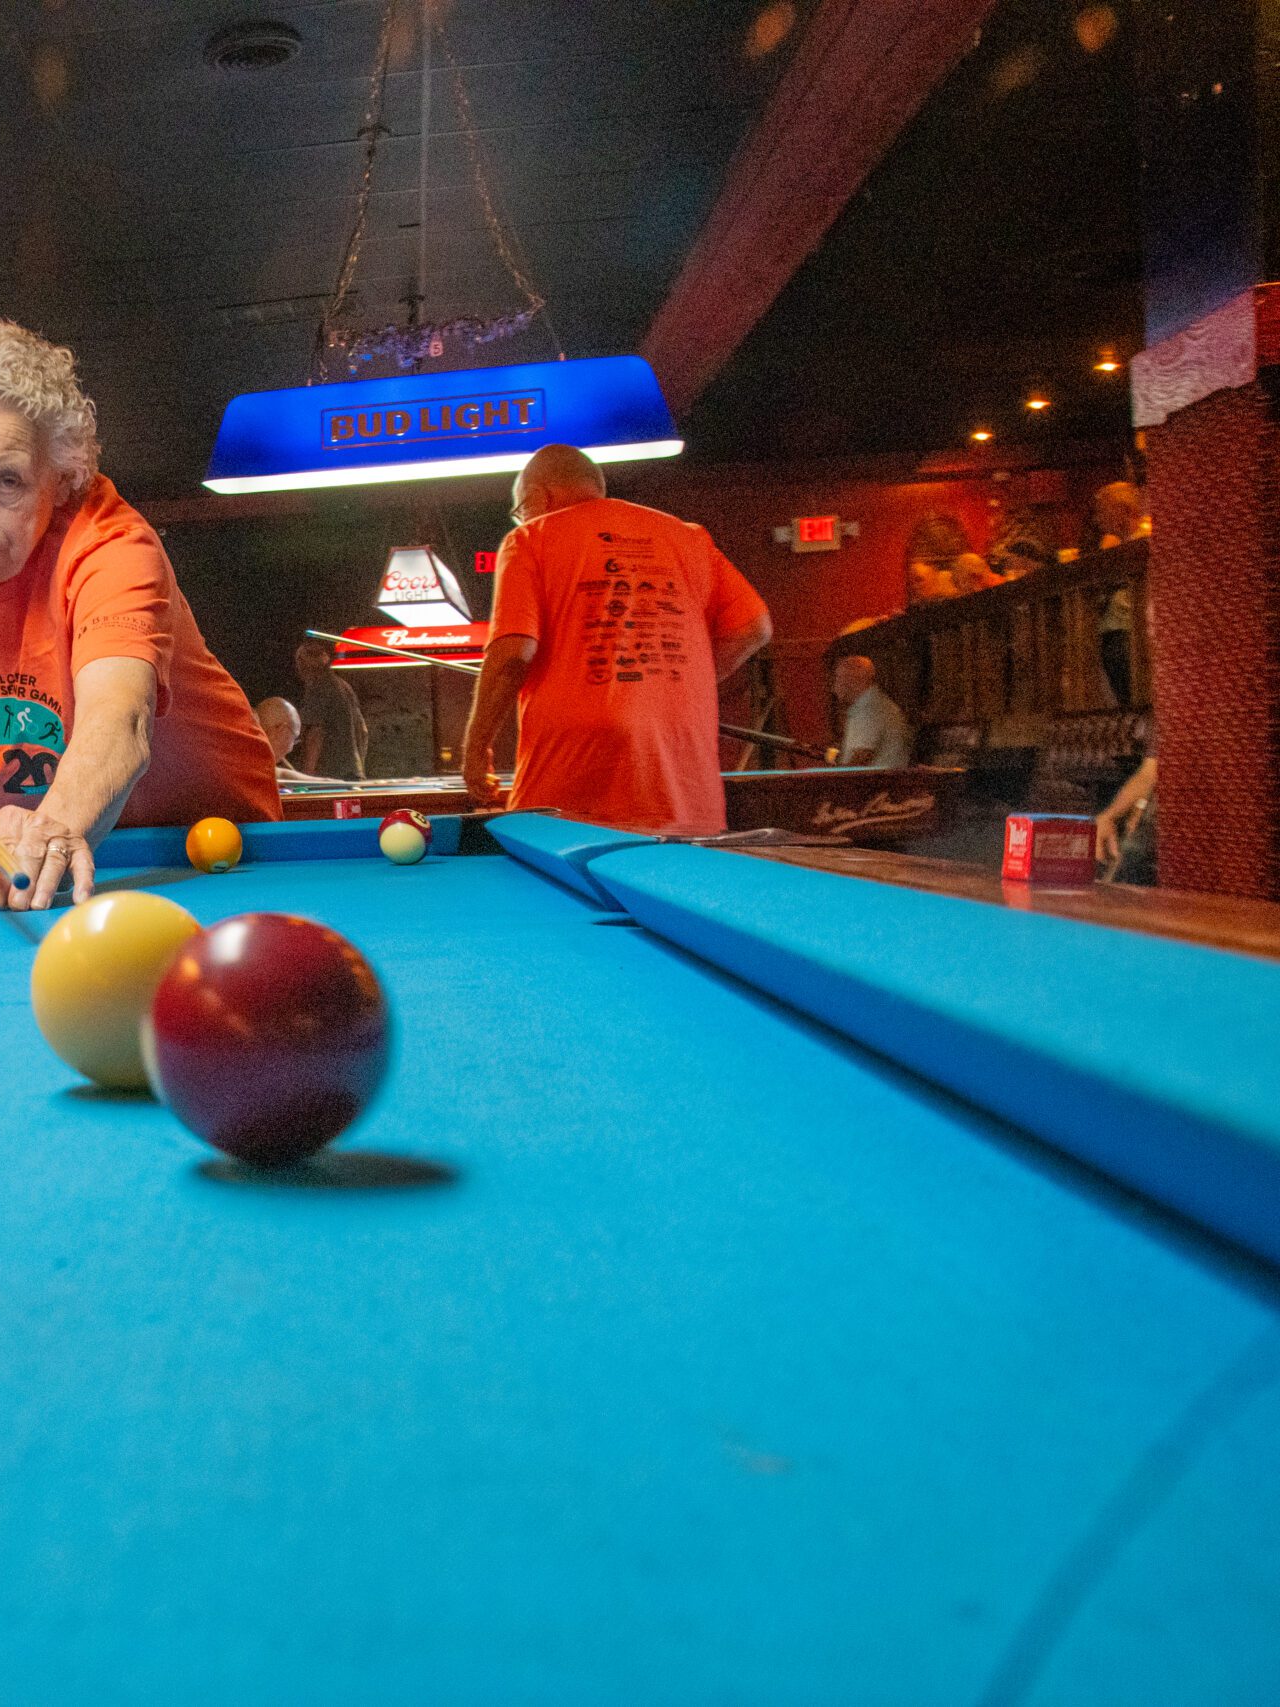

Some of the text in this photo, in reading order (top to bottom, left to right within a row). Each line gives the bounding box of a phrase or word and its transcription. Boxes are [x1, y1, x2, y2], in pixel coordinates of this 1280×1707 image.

[331, 397, 536, 442] BUD LIGHT
[383, 571, 441, 591] Coors
[394, 590, 430, 601] LIGHT
[381, 630, 471, 646] Budweiser
